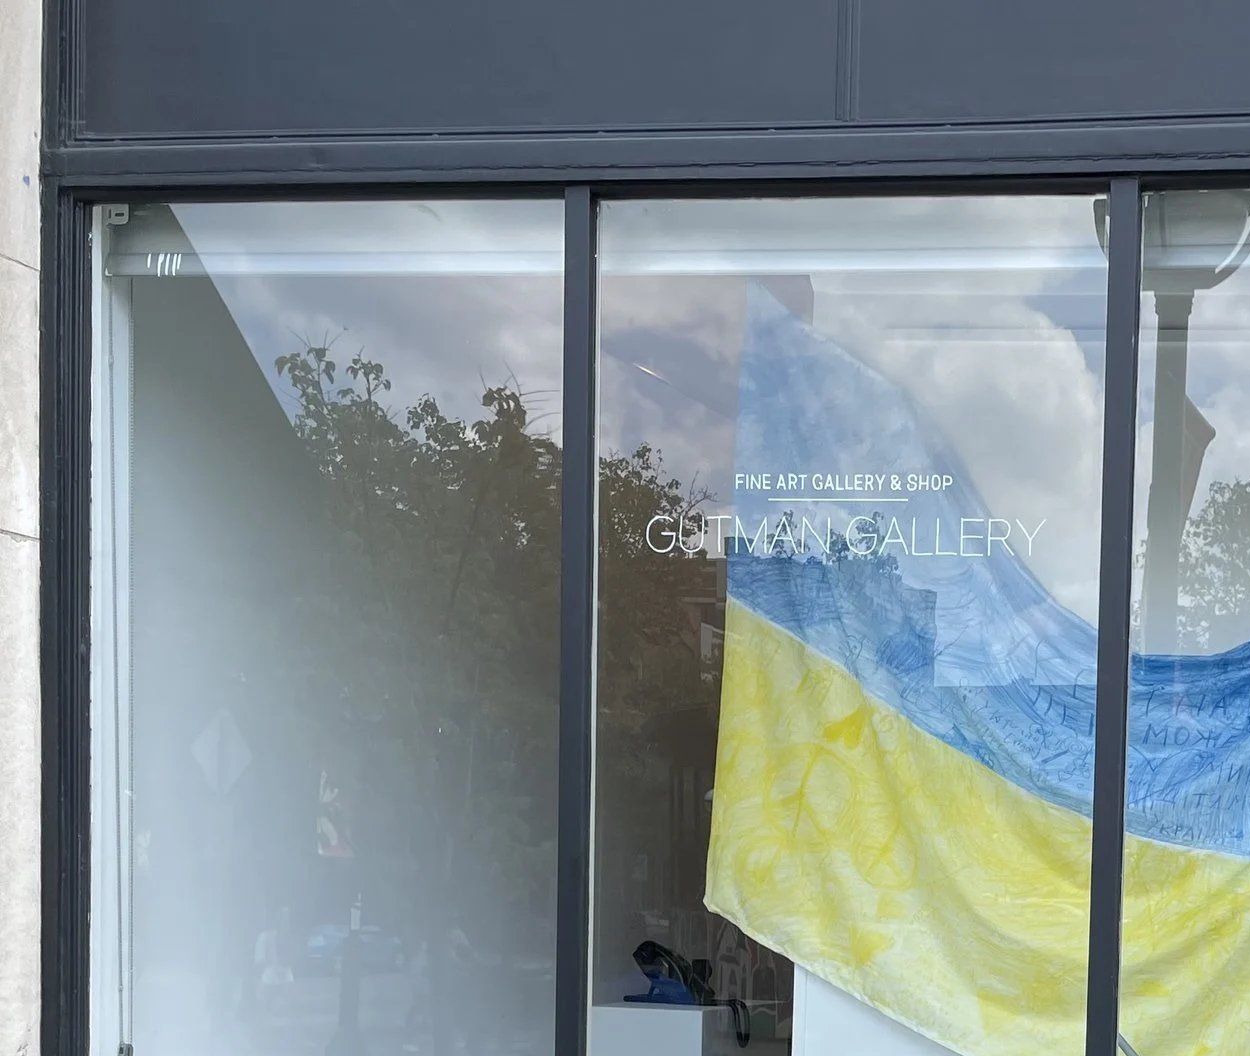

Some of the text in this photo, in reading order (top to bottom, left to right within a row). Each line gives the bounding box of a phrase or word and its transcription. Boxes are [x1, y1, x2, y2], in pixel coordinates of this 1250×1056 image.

[735, 473, 953, 491] FINE ART GALLERY & SHOP
[645, 515, 1047, 557] GUTMAN GALLERY
